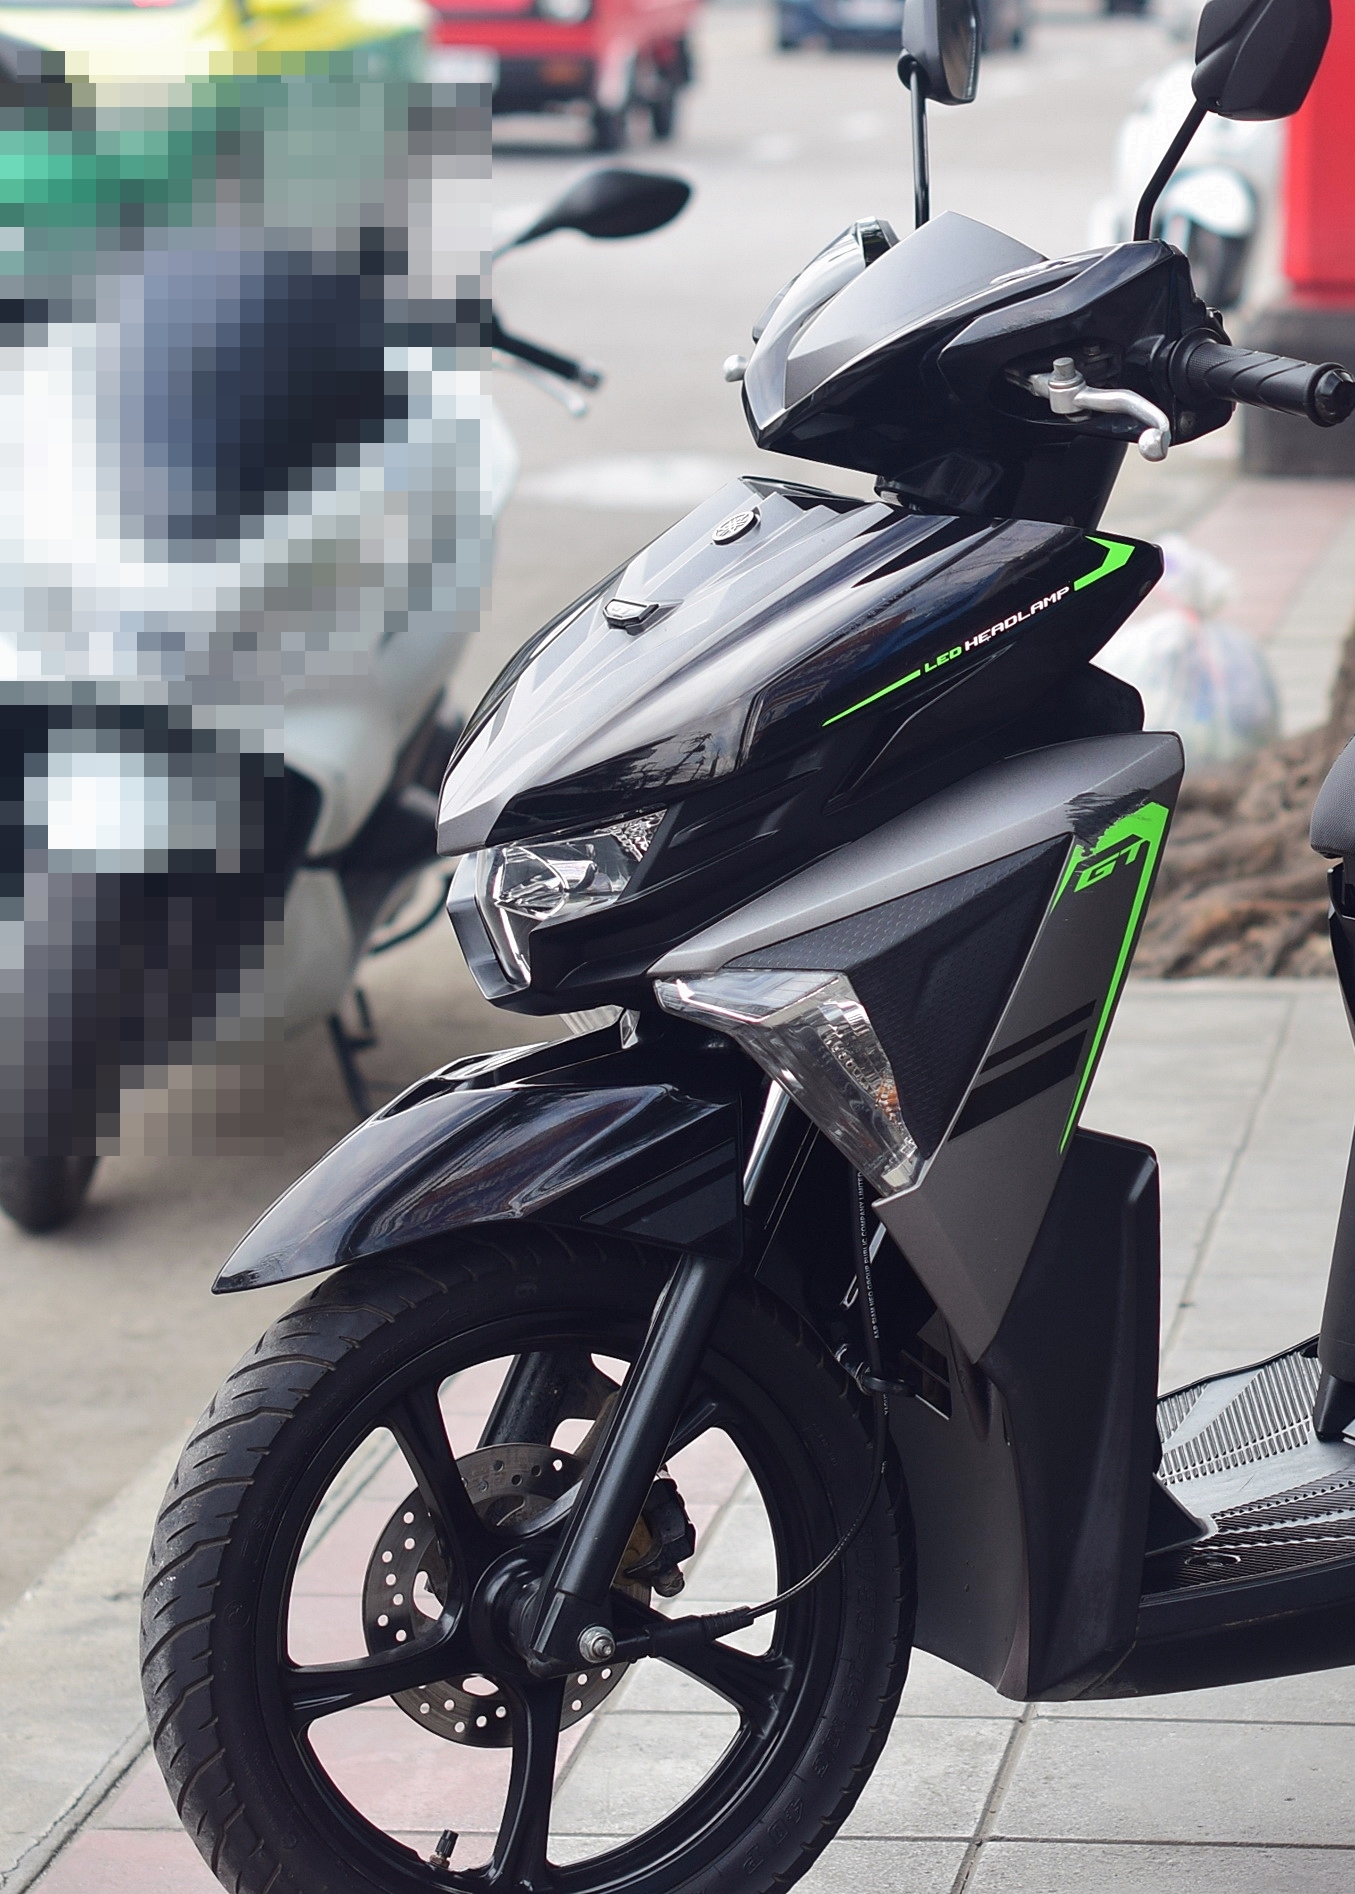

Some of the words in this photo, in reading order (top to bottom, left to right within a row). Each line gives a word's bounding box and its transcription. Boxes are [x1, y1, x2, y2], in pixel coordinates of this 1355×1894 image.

[924, 646, 962, 674] LED
[964, 586, 1070, 652] HEADLAMP
[862, 1238, 870, 1264] PUBLIC
